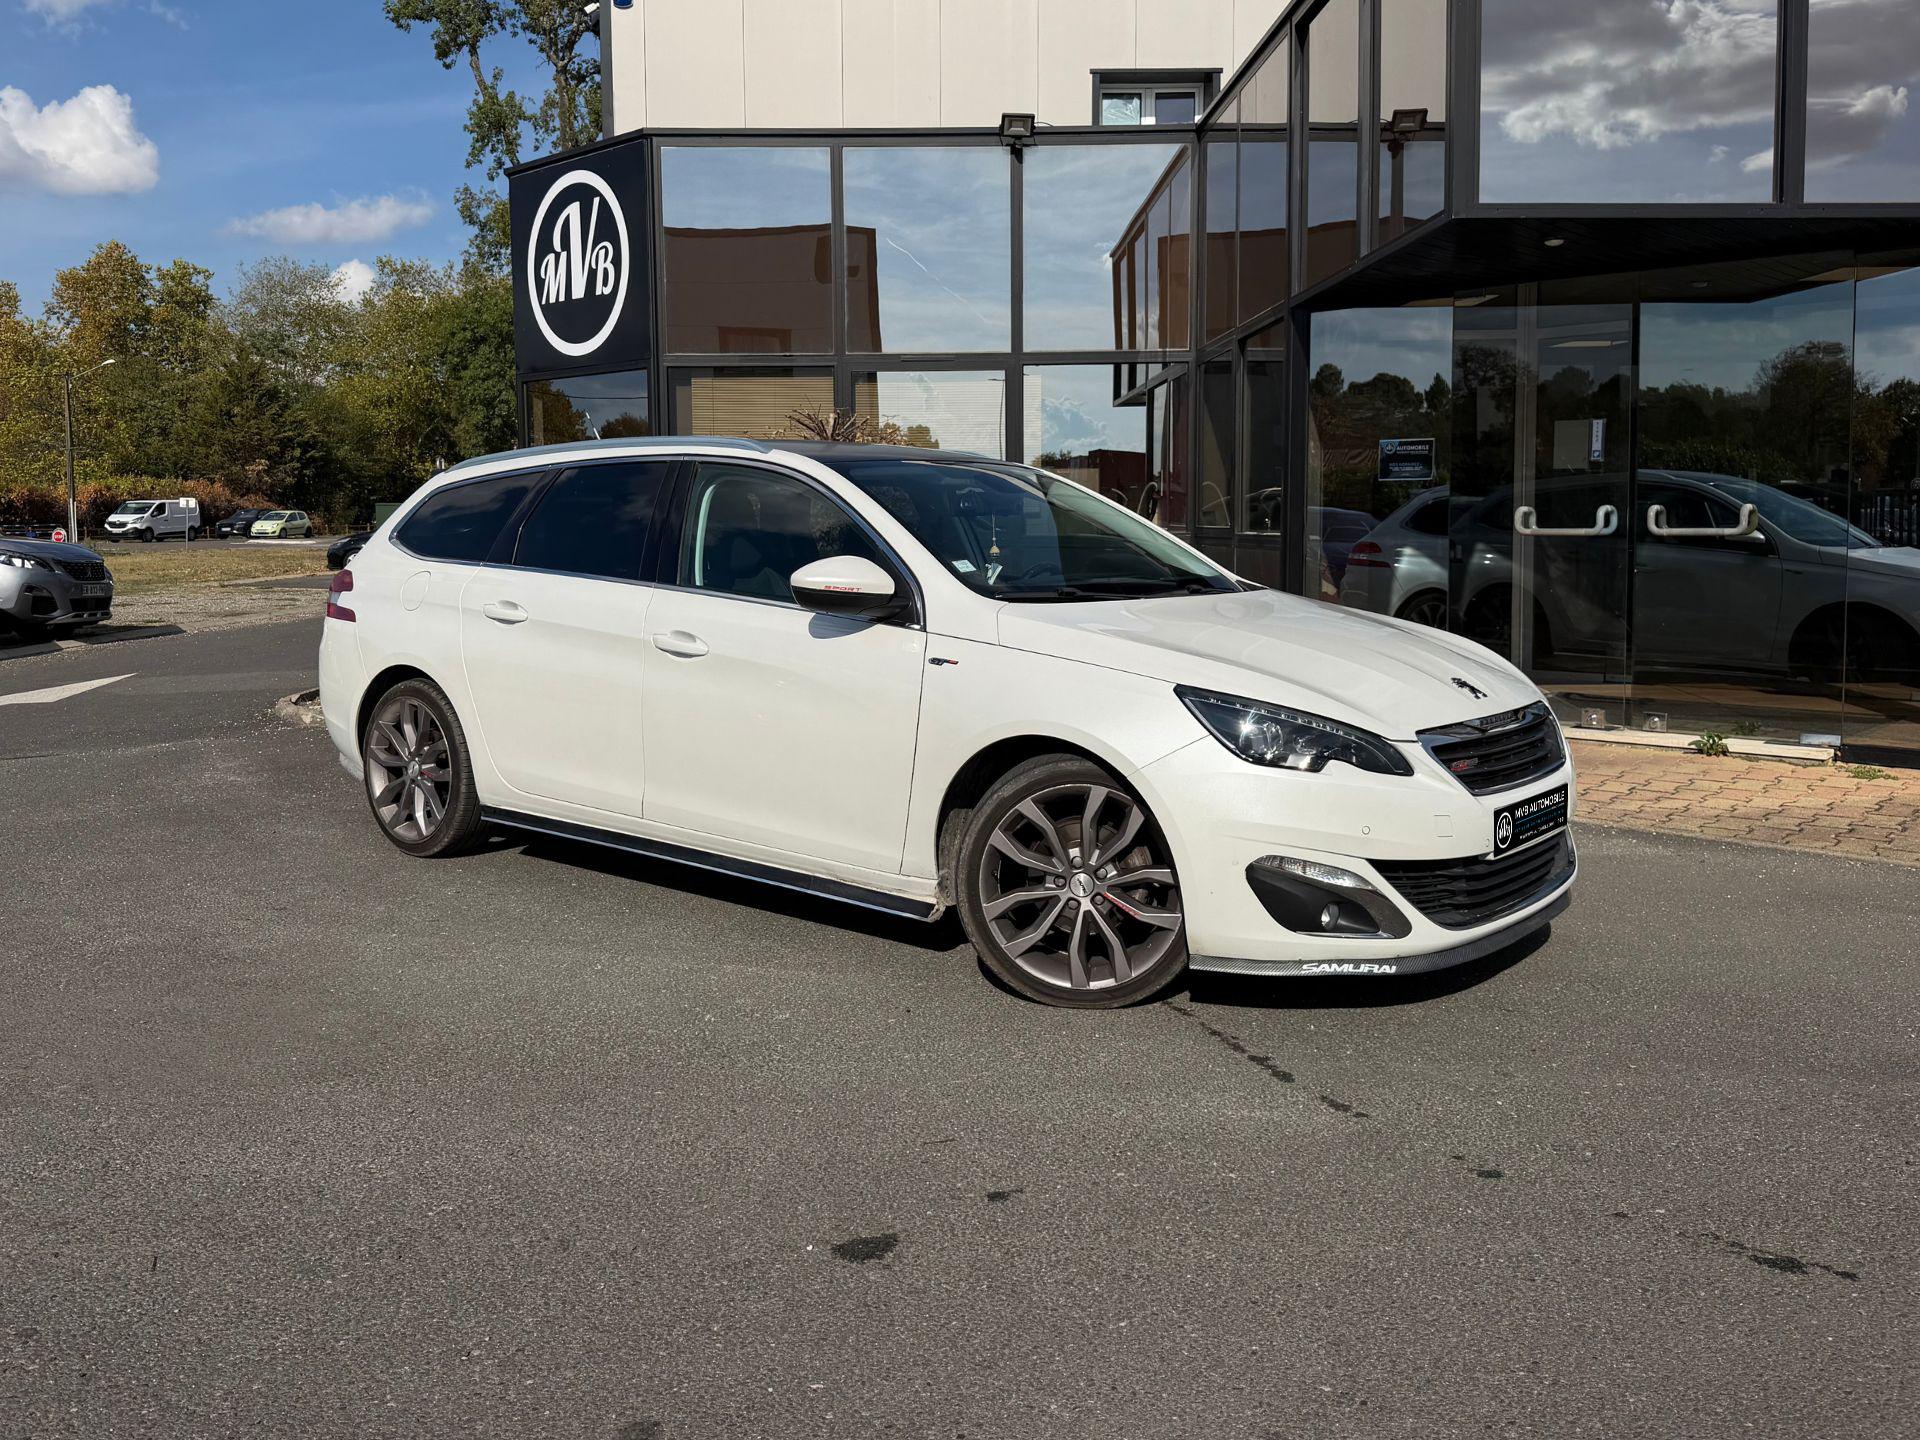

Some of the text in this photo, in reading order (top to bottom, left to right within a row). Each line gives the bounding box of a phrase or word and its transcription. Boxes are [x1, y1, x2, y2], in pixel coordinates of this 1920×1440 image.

[540, 196, 615, 305] MVB
[1514, 805, 1529, 819] MVB
[1529, 790, 1565, 813] AUTOMOBILE
[1301, 962, 1397, 974] SAMURAI
